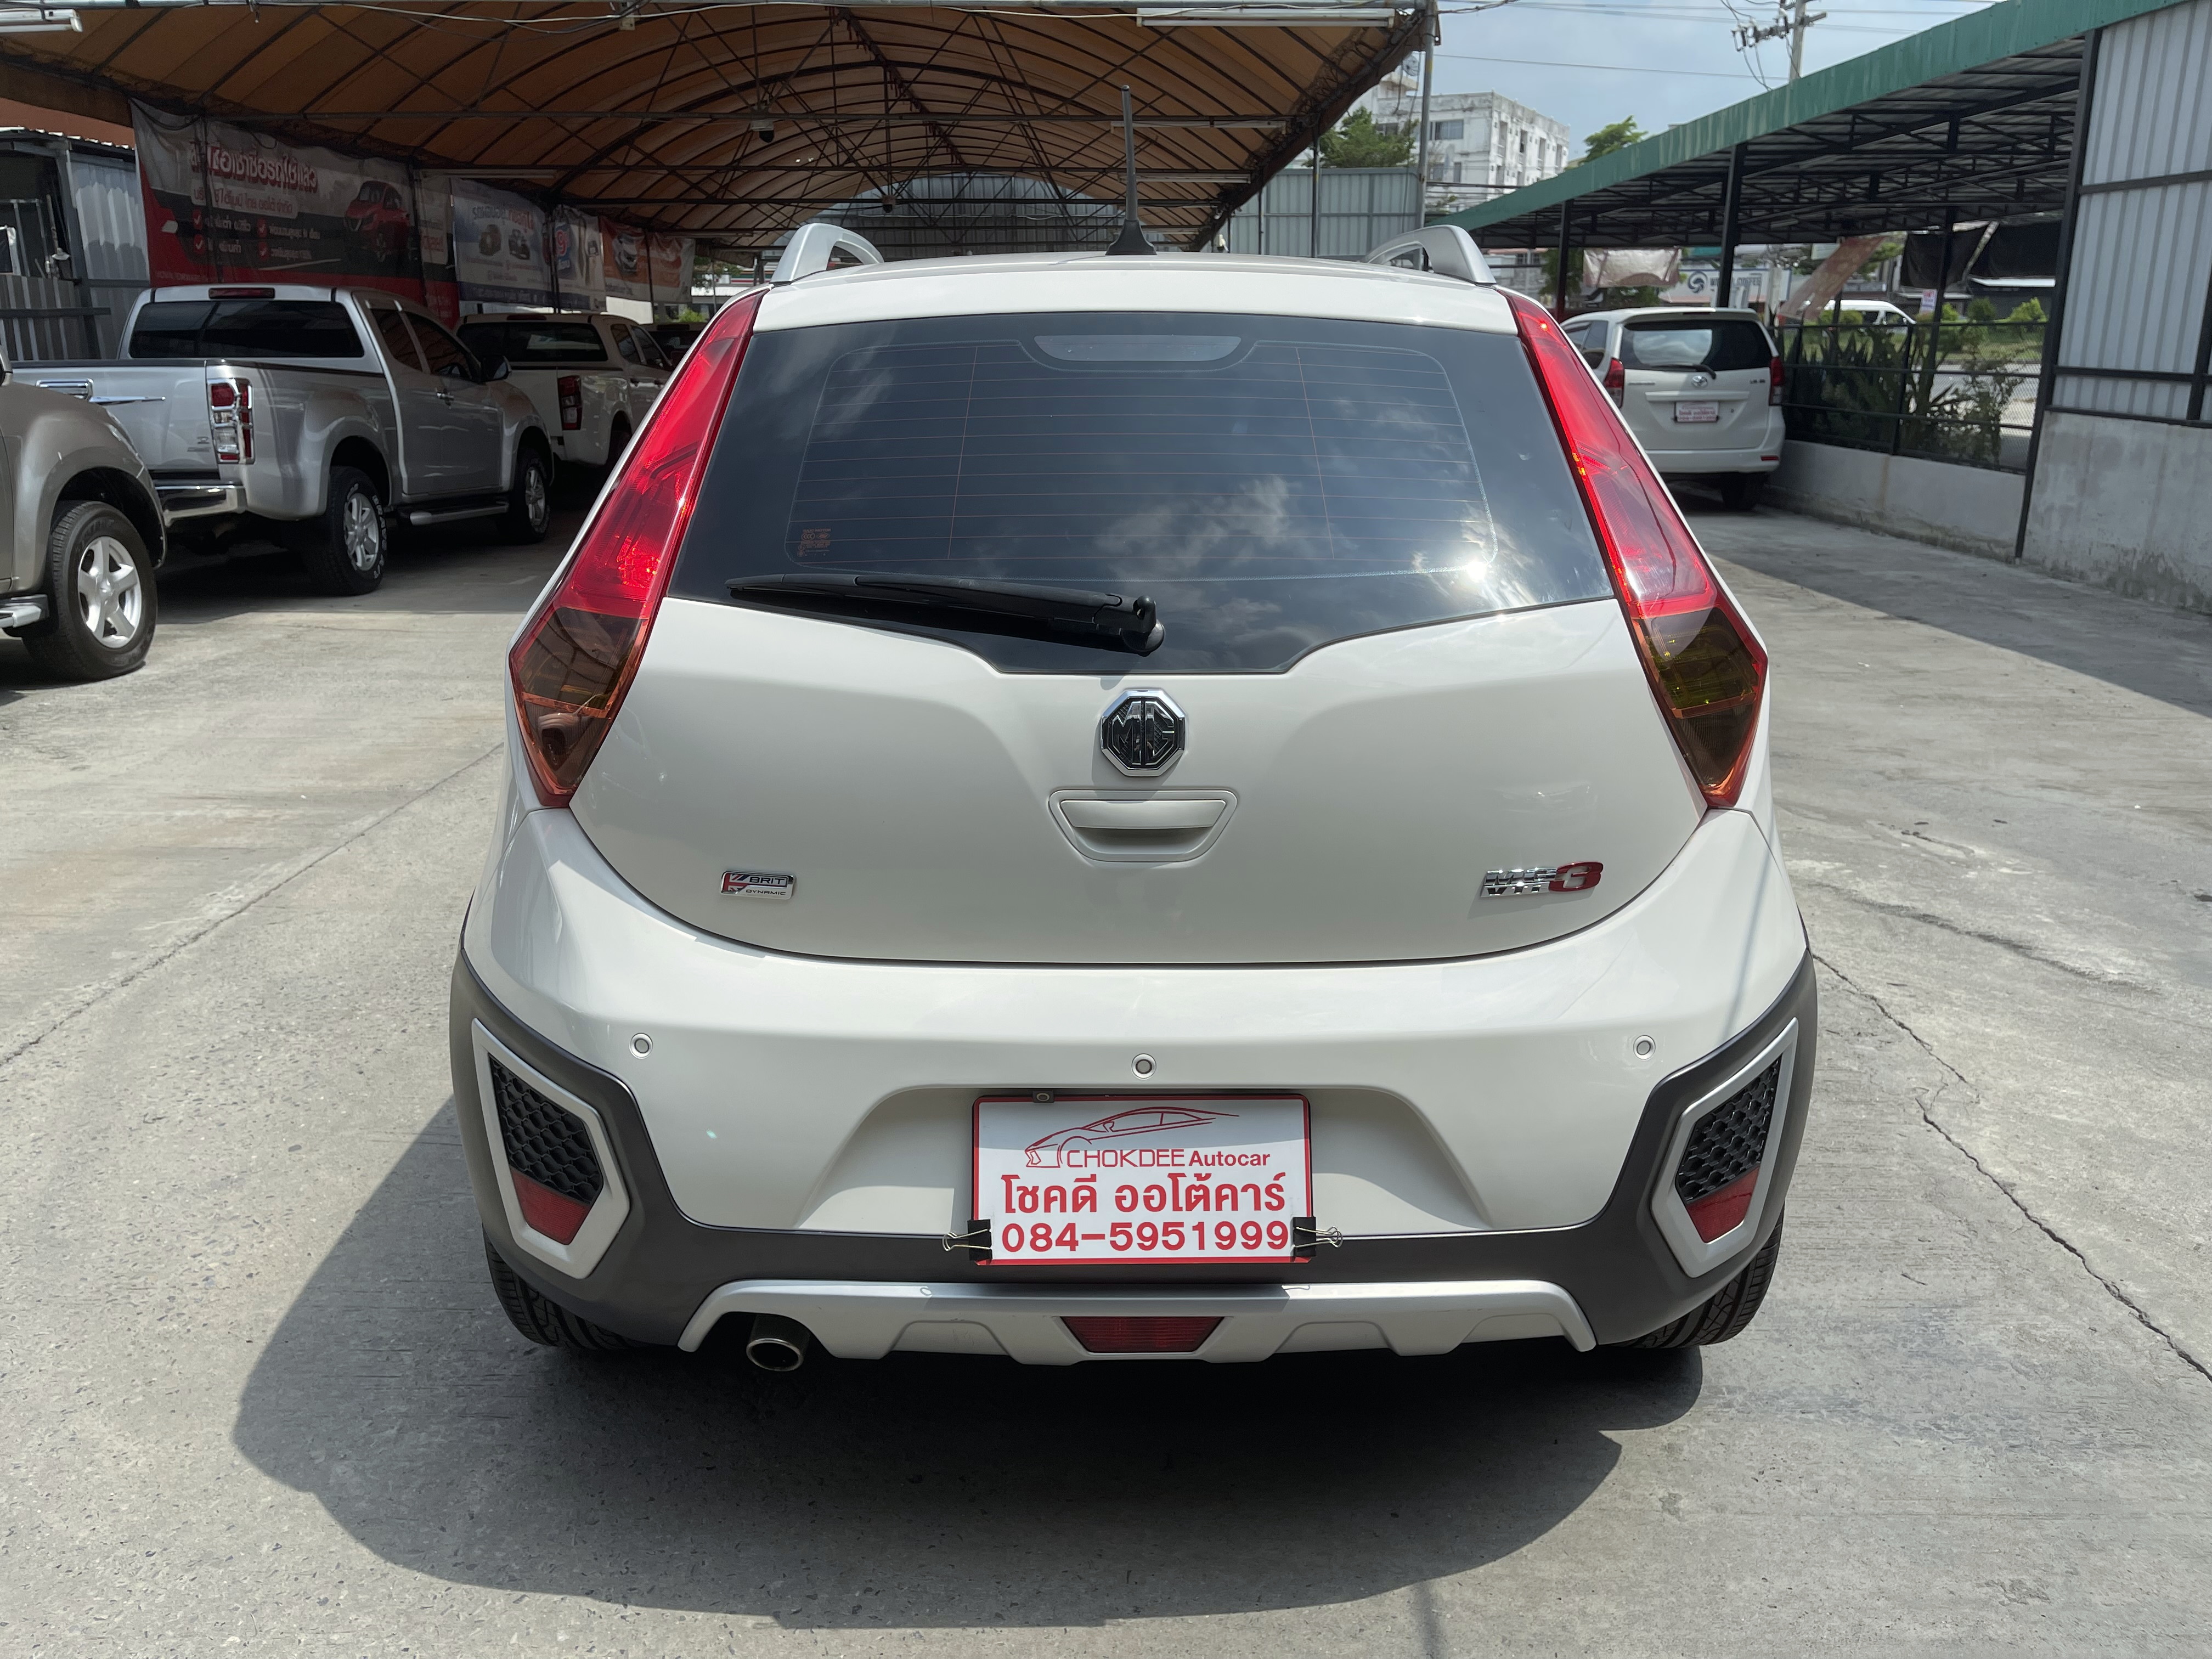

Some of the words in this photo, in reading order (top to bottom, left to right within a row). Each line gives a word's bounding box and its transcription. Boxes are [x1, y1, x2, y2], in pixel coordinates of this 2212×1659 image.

[1111, 701, 1175, 766] MG
[1484, 861, 1604, 892] MG3
[1066, 1149, 1185, 1167] CHOKDEE
[1189, 1150, 1271, 1167] Autocar
[1001, 1173, 1097, 1214] โชคดี
[1115, 1172, 1286, 1212] ออโต้คาร์
[1002, 1221, 1289, 1252] 084-5951999
